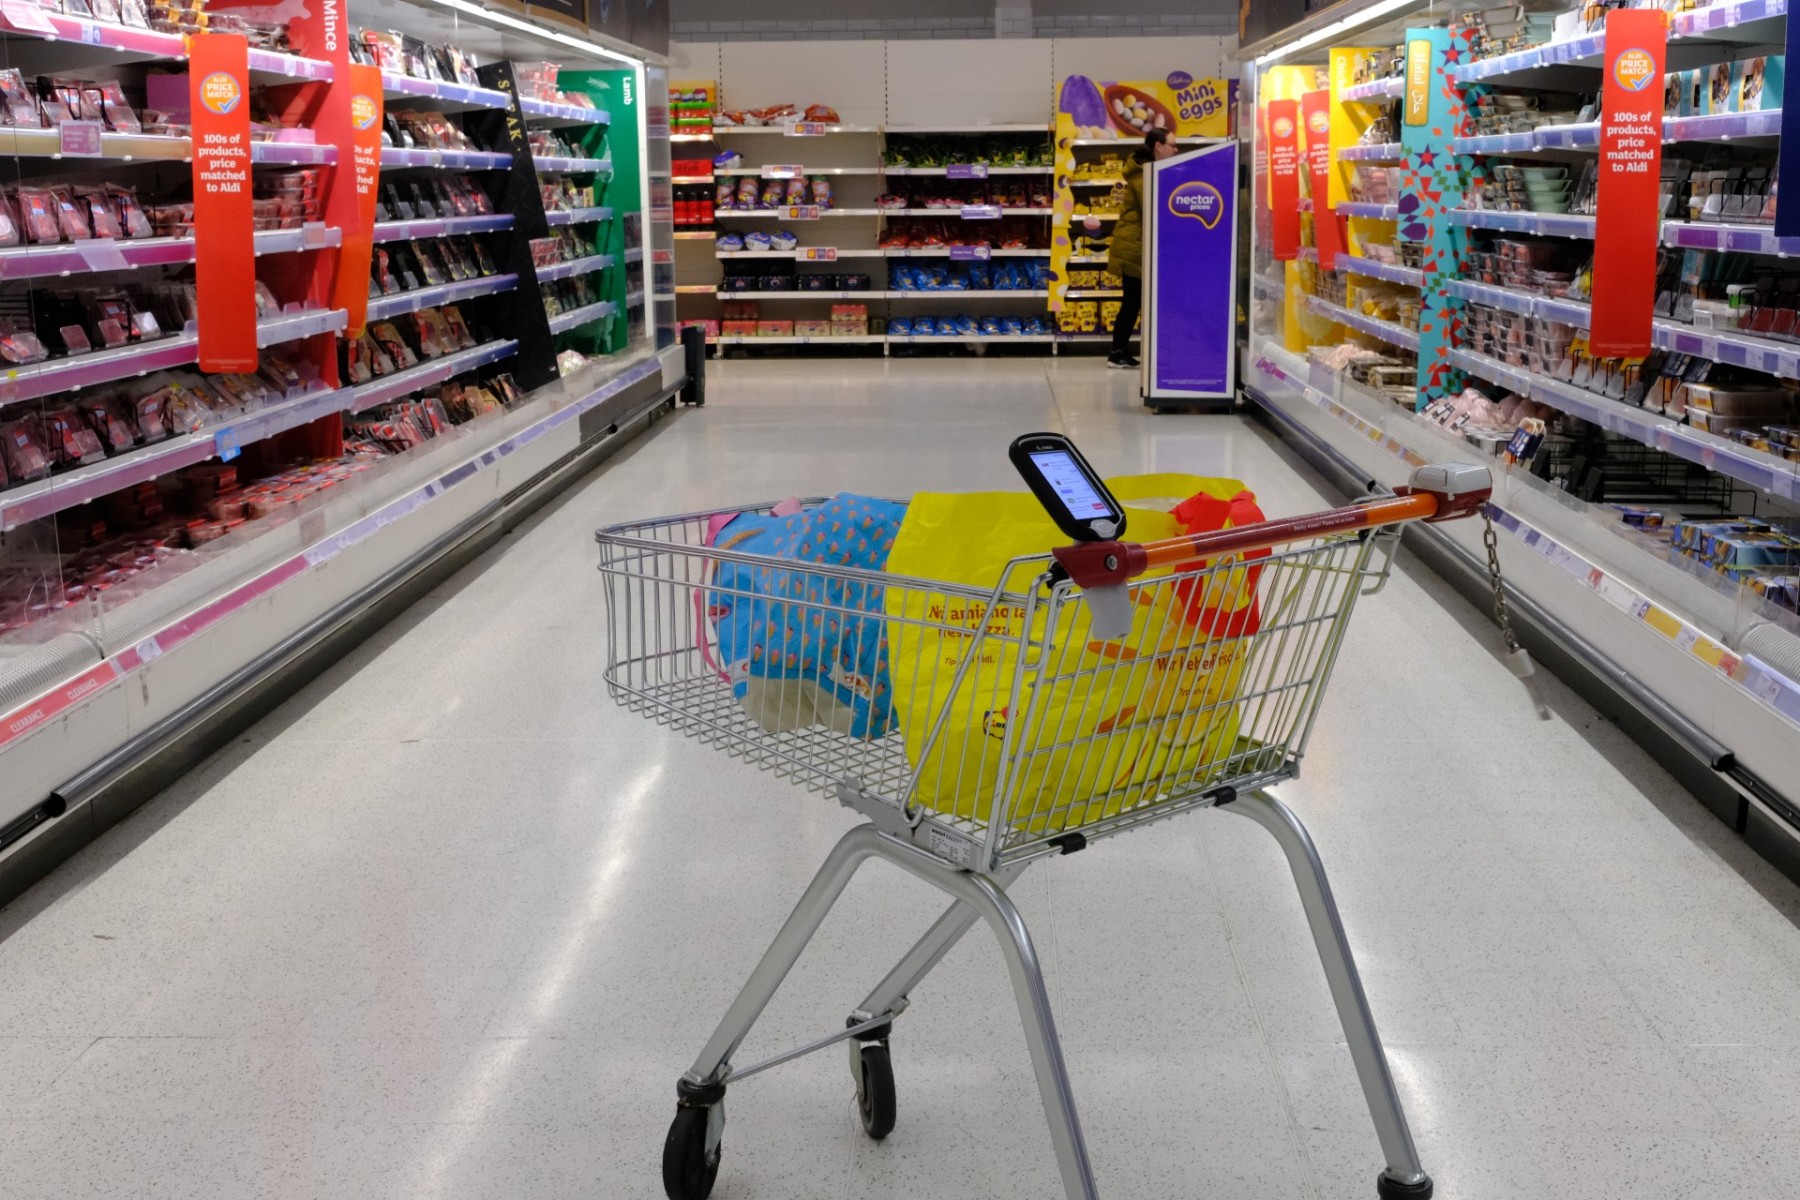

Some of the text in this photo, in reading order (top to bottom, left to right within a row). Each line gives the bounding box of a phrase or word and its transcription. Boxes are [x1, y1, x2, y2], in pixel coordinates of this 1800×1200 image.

[323, 0, 339, 51] Mince
[1621, 60, 1648, 68] PRICE
[1621, 67, 1648, 75] MATCH
[206, 83, 233, 91] PRICE
[623, 77, 633, 105] Lamb
[1177, 80, 1216, 107] Mini
[1180, 97, 1223, 120] eggs
[1613, 112, 1652, 122] 100s of
[1607, 125, 1656, 137] products,
[204, 134, 240, 143] 100s of
[1618, 138, 1645, 149] price
[198, 146, 246, 157] products,
[364, 146, 373, 154] of
[1607, 150, 1654, 160] matched
[210, 159, 236, 170] price
[356, 156, 376, 166] ucts,
[1612, 162, 1648, 172] to Aldi
[200, 171, 245, 180] matched
[206, 182, 241, 192] to Aldi
[357, 185, 368, 194] ldi
[1176, 194, 1215, 205] nectar
[1180, 655, 1216, 671] leben
[67, 677, 99, 700] CLEARANCE
[10, 708, 45, 733] CLEARANCE
